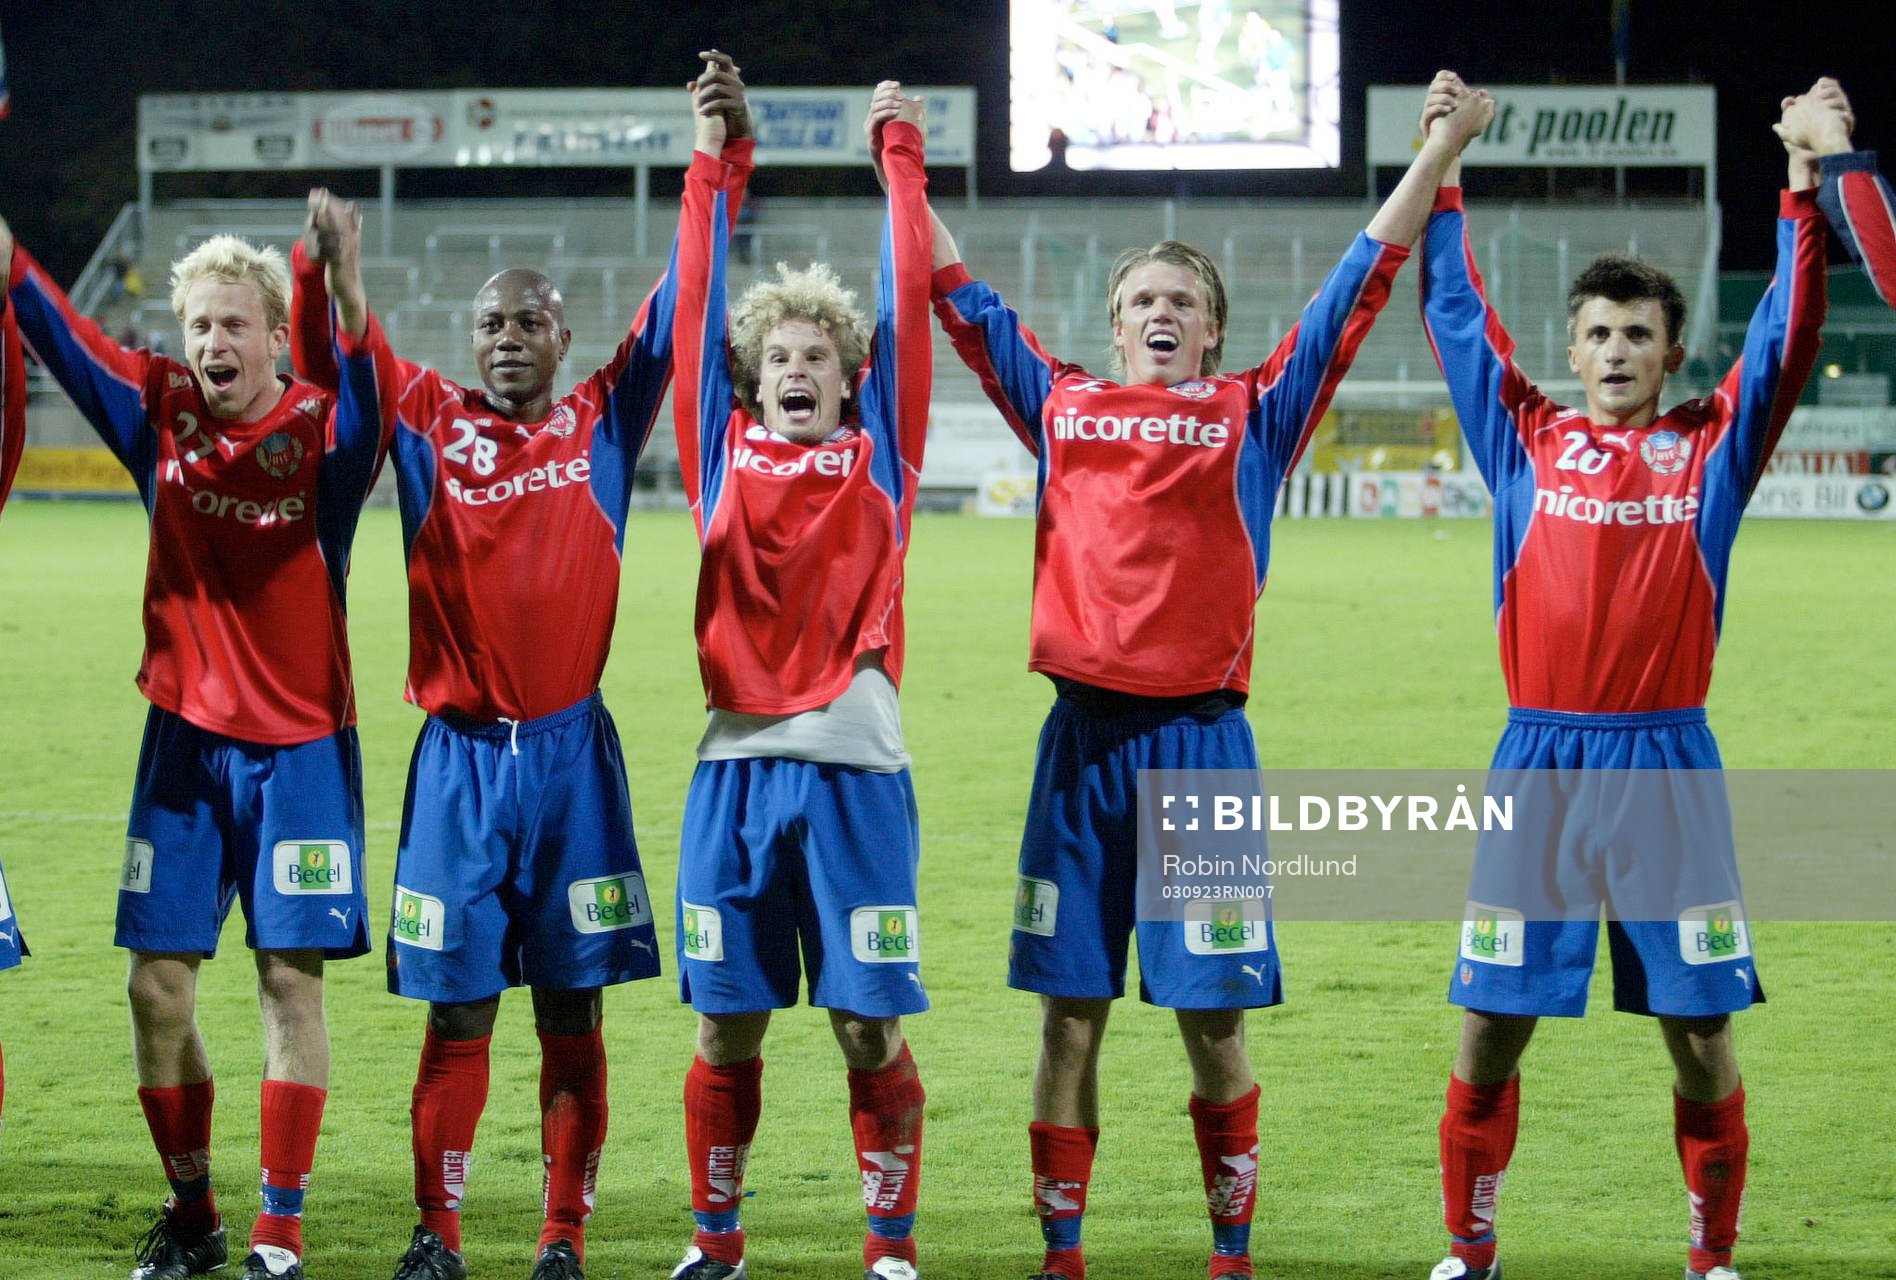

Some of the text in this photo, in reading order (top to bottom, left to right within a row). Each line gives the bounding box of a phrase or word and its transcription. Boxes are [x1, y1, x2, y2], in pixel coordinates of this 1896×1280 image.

[1053, 408, 1231, 448] nicorette
[443, 418, 498, 476] 28
[1535, 486, 1699, 525] nicorette
[288, 861, 341, 883] Becel
[586, 895, 640, 922] Becel
[1201, 920, 1255, 942] Becel
[443, 1151, 464, 1185] INTER
[708, 1146, 736, 1179] INTER
[877, 1171, 908, 1210] INTER
[1222, 1170, 1257, 1217] INTER
[1471, 1175, 1498, 1209] INTER
